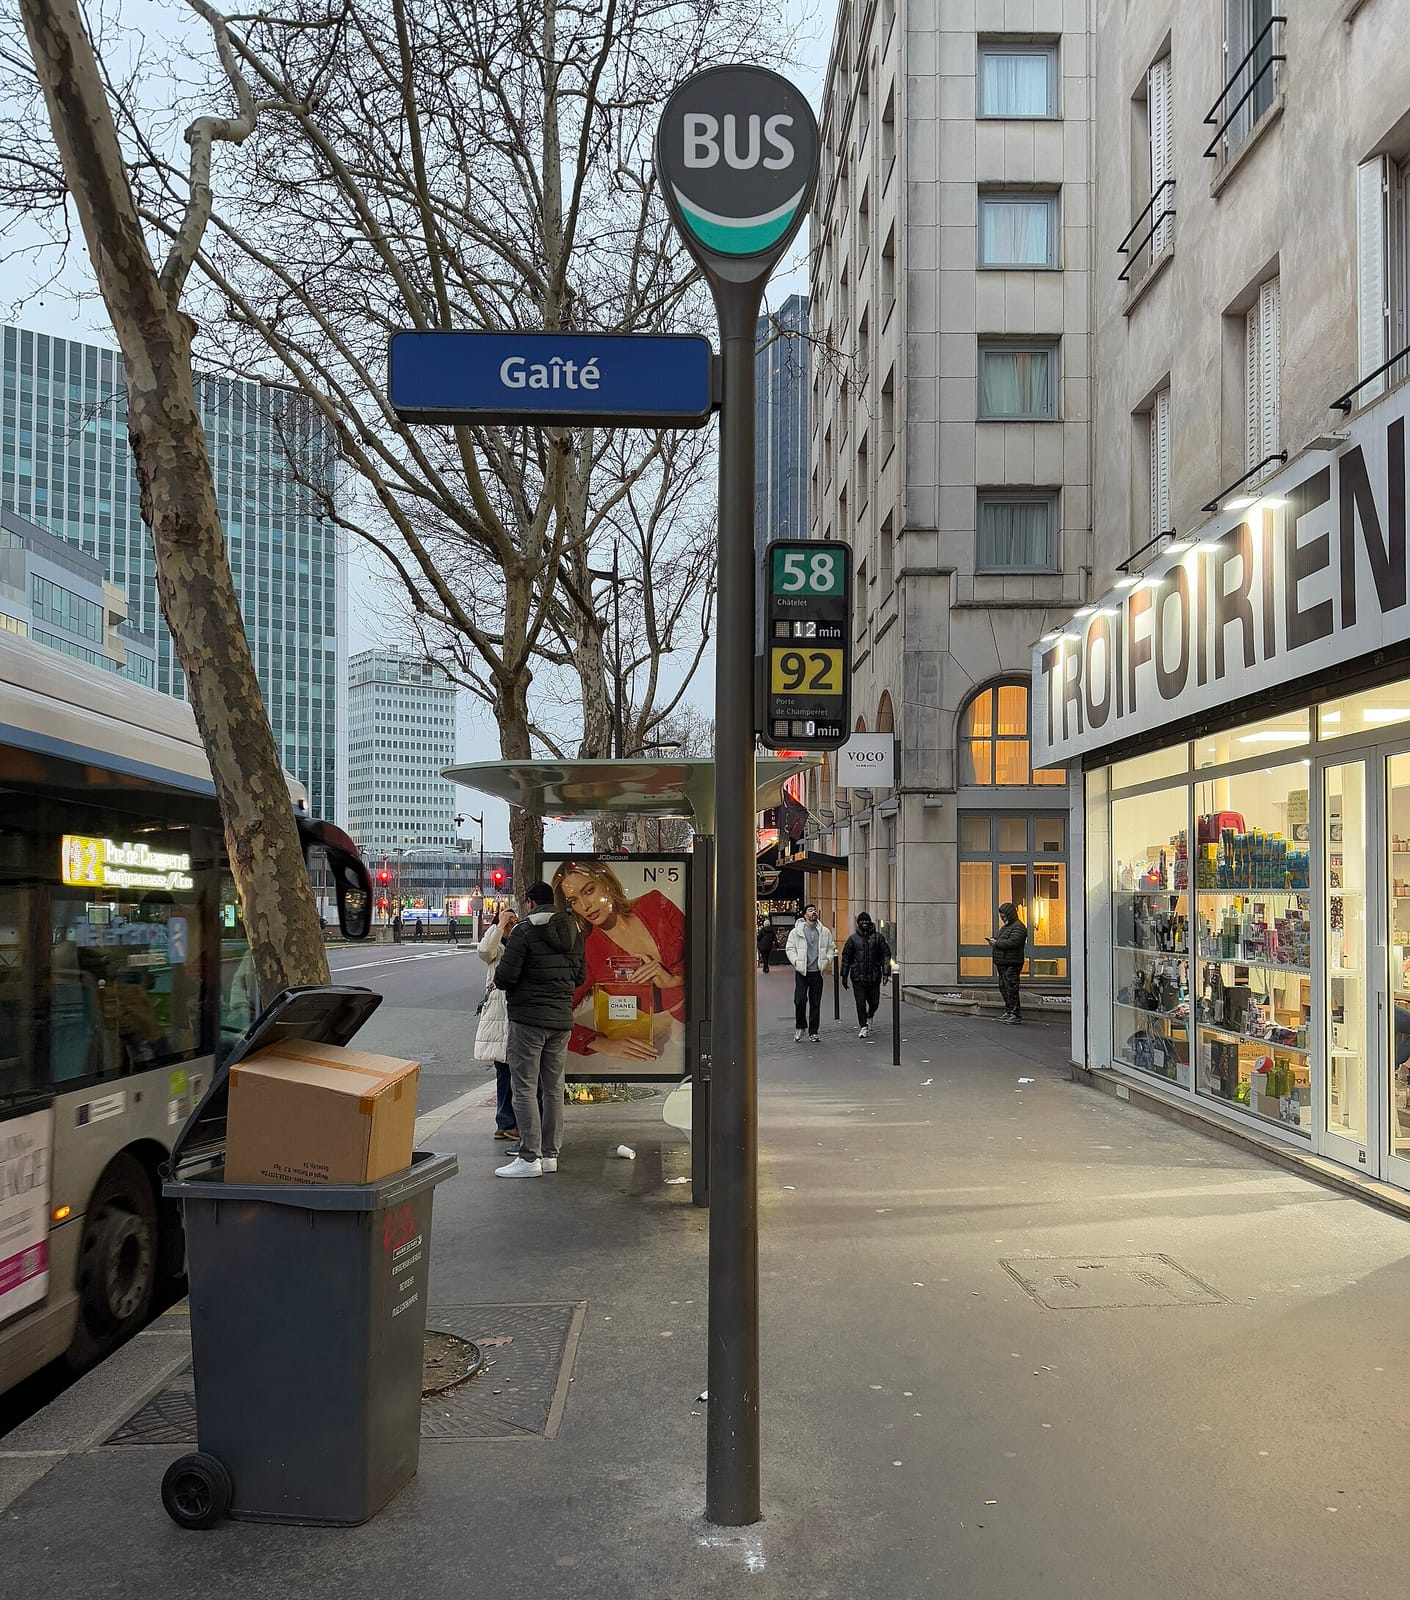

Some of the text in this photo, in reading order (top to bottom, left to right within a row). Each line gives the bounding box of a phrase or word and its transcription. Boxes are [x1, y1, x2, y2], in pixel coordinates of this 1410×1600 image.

[683, 113, 795, 170] BUS
[499, 356, 600, 390] Gaîté
[781, 553, 835, 592] 58
[1041, 415, 1407, 747] TROIFOIRIEN
[793, 621, 841, 638] 12 min
[780, 652, 833, 690] 92
[786, 708, 828, 716] Champerret
[806, 720, 840, 737] 0 min
